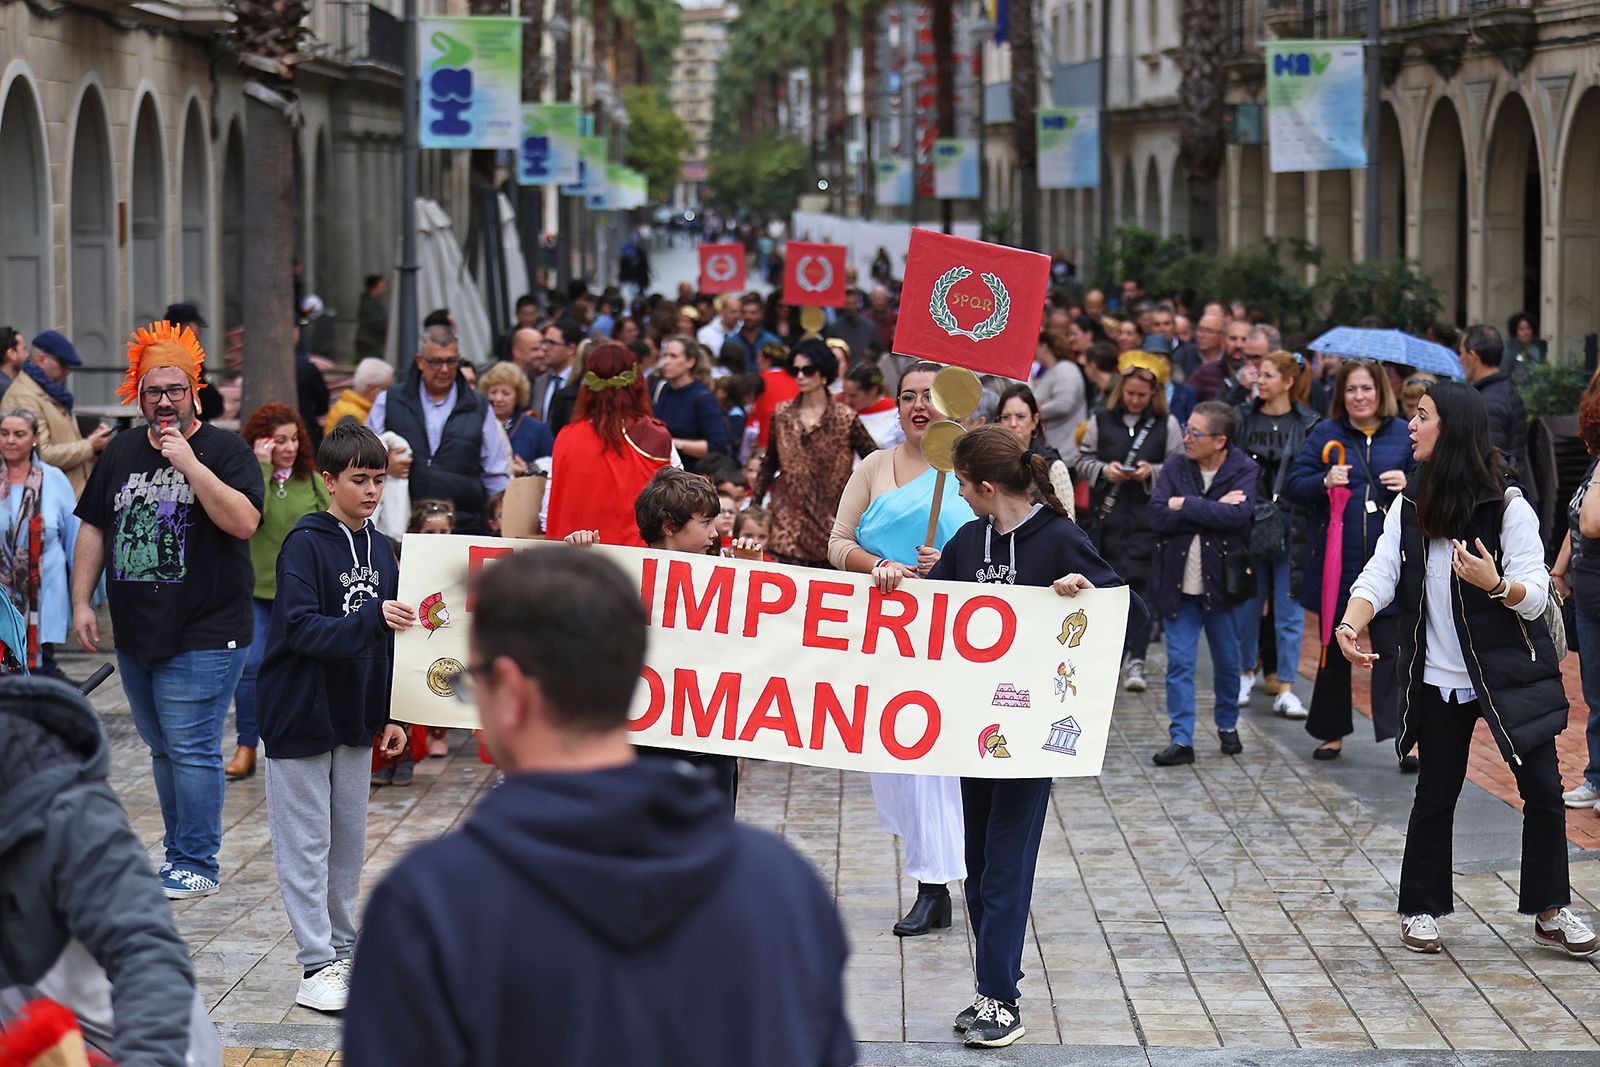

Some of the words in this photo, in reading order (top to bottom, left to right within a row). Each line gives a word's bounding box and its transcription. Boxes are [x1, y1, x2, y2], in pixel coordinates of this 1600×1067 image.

[1274, 53, 1332, 76] H2V
[952, 293, 993, 312] SPQR
[127, 466, 185, 489] BLACK
[339, 567, 380, 587] SAFA
[640, 558, 1017, 663] IMPERIO
